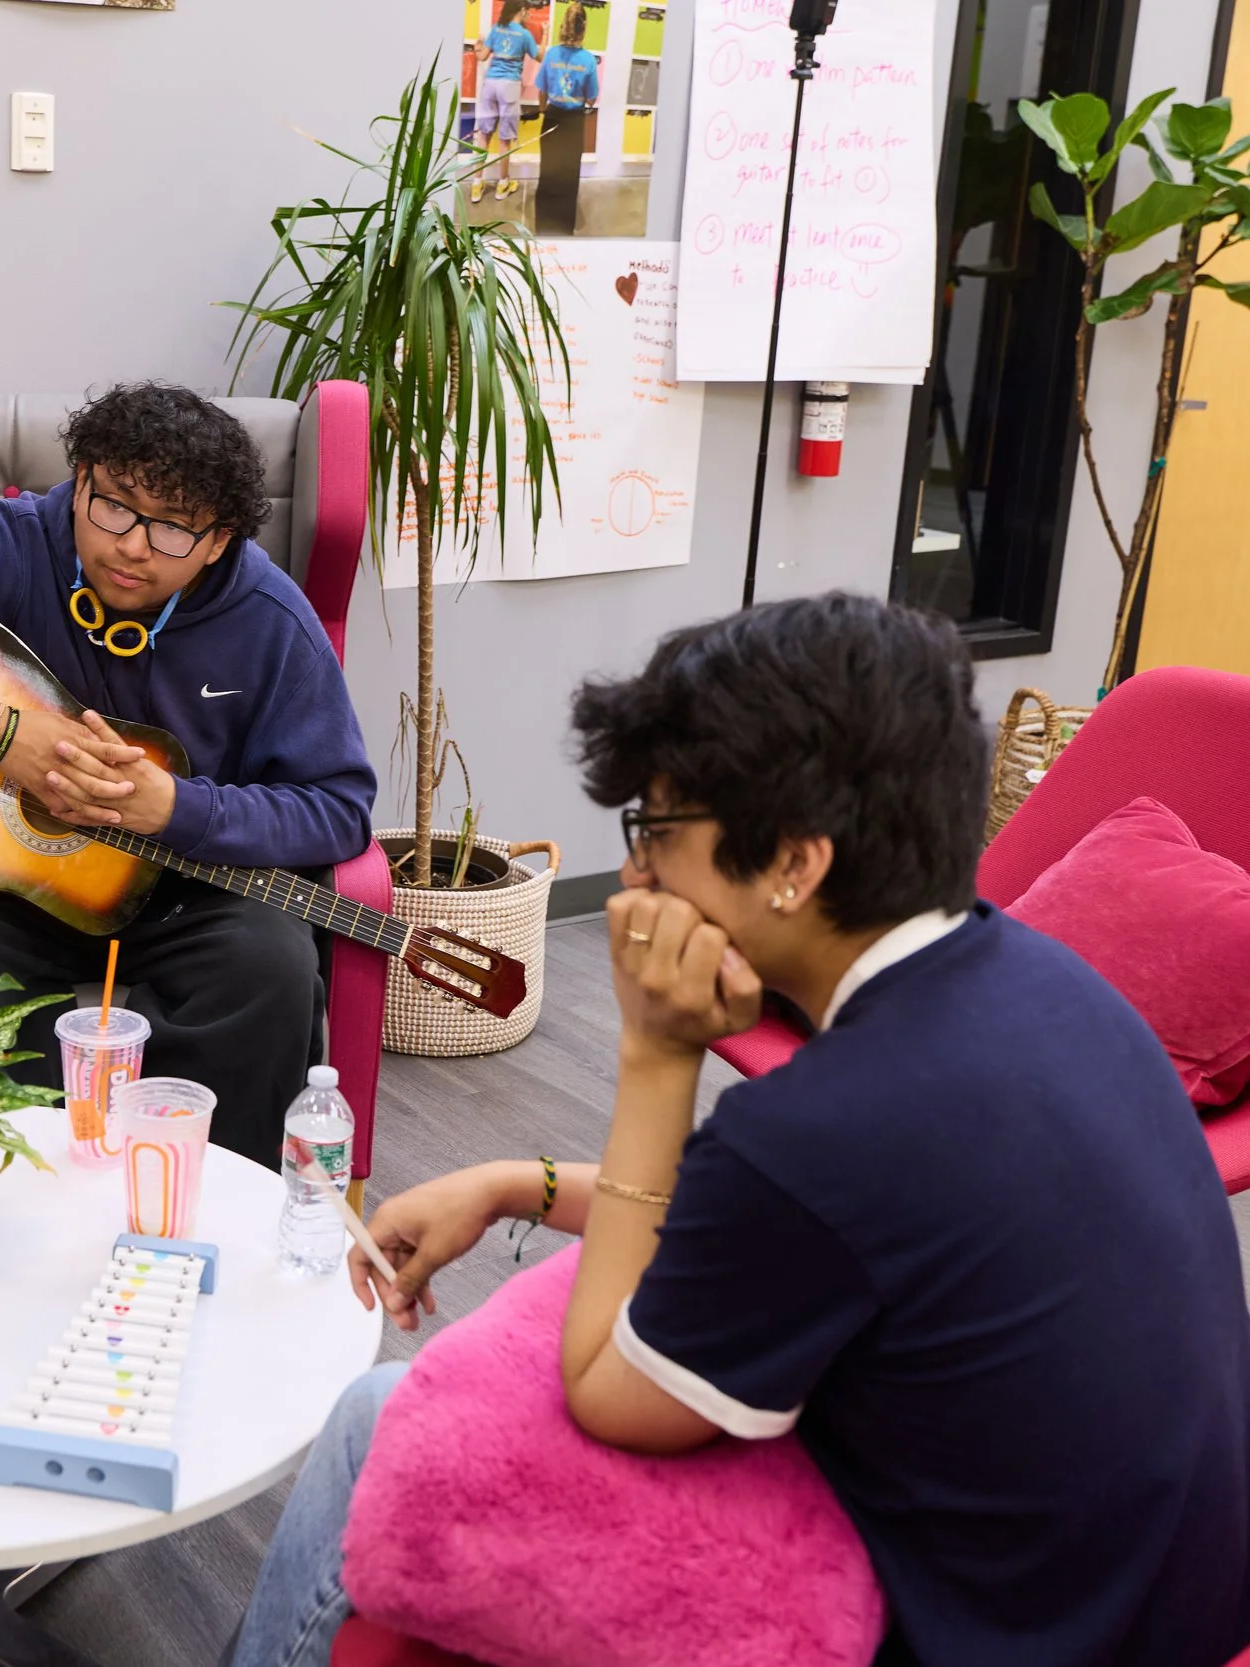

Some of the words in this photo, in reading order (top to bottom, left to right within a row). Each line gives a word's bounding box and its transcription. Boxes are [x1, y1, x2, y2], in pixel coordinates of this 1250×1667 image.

[746, 59, 777, 83] one
[851, 63, 919, 103] pattern
[739, 131, 770, 152] one
[810, 122, 831, 162] of
[881, 126, 909, 161] for
[732, 163, 786, 198] guitar
[800, 170, 816, 188] to
[819, 164, 843, 196] fit
[849, 233, 885, 250] once
[732, 263, 745, 291] to
